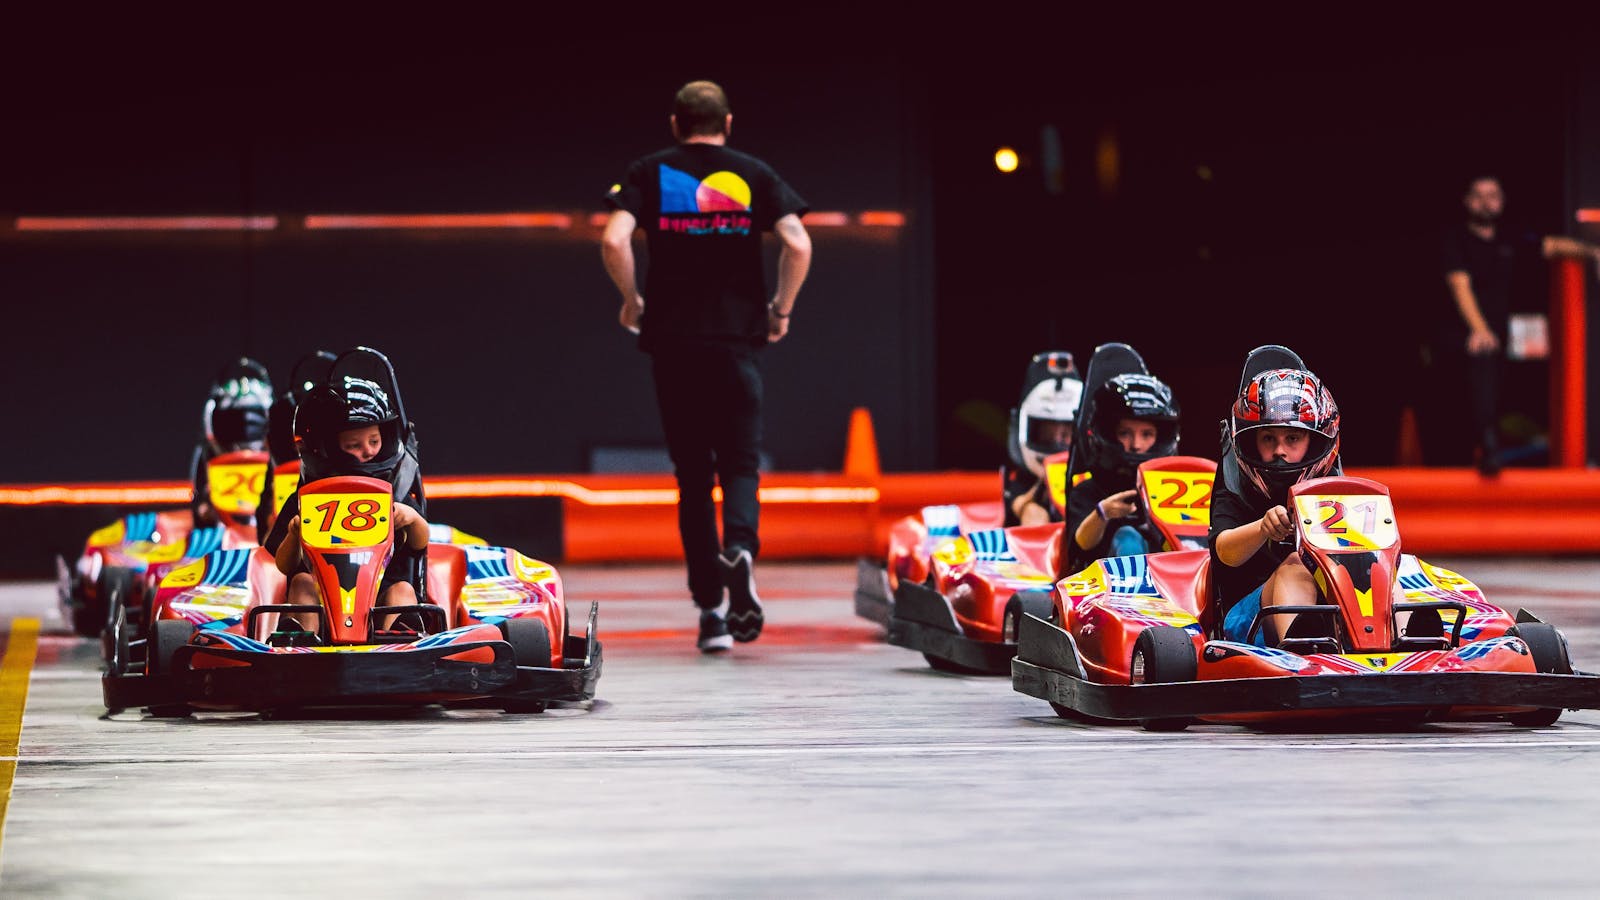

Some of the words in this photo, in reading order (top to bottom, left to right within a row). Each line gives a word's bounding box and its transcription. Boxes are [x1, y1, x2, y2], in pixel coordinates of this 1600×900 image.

[1158, 478, 1214, 509] 22
[315, 499, 381, 532] 18
[1311, 500, 1378, 534] 21
